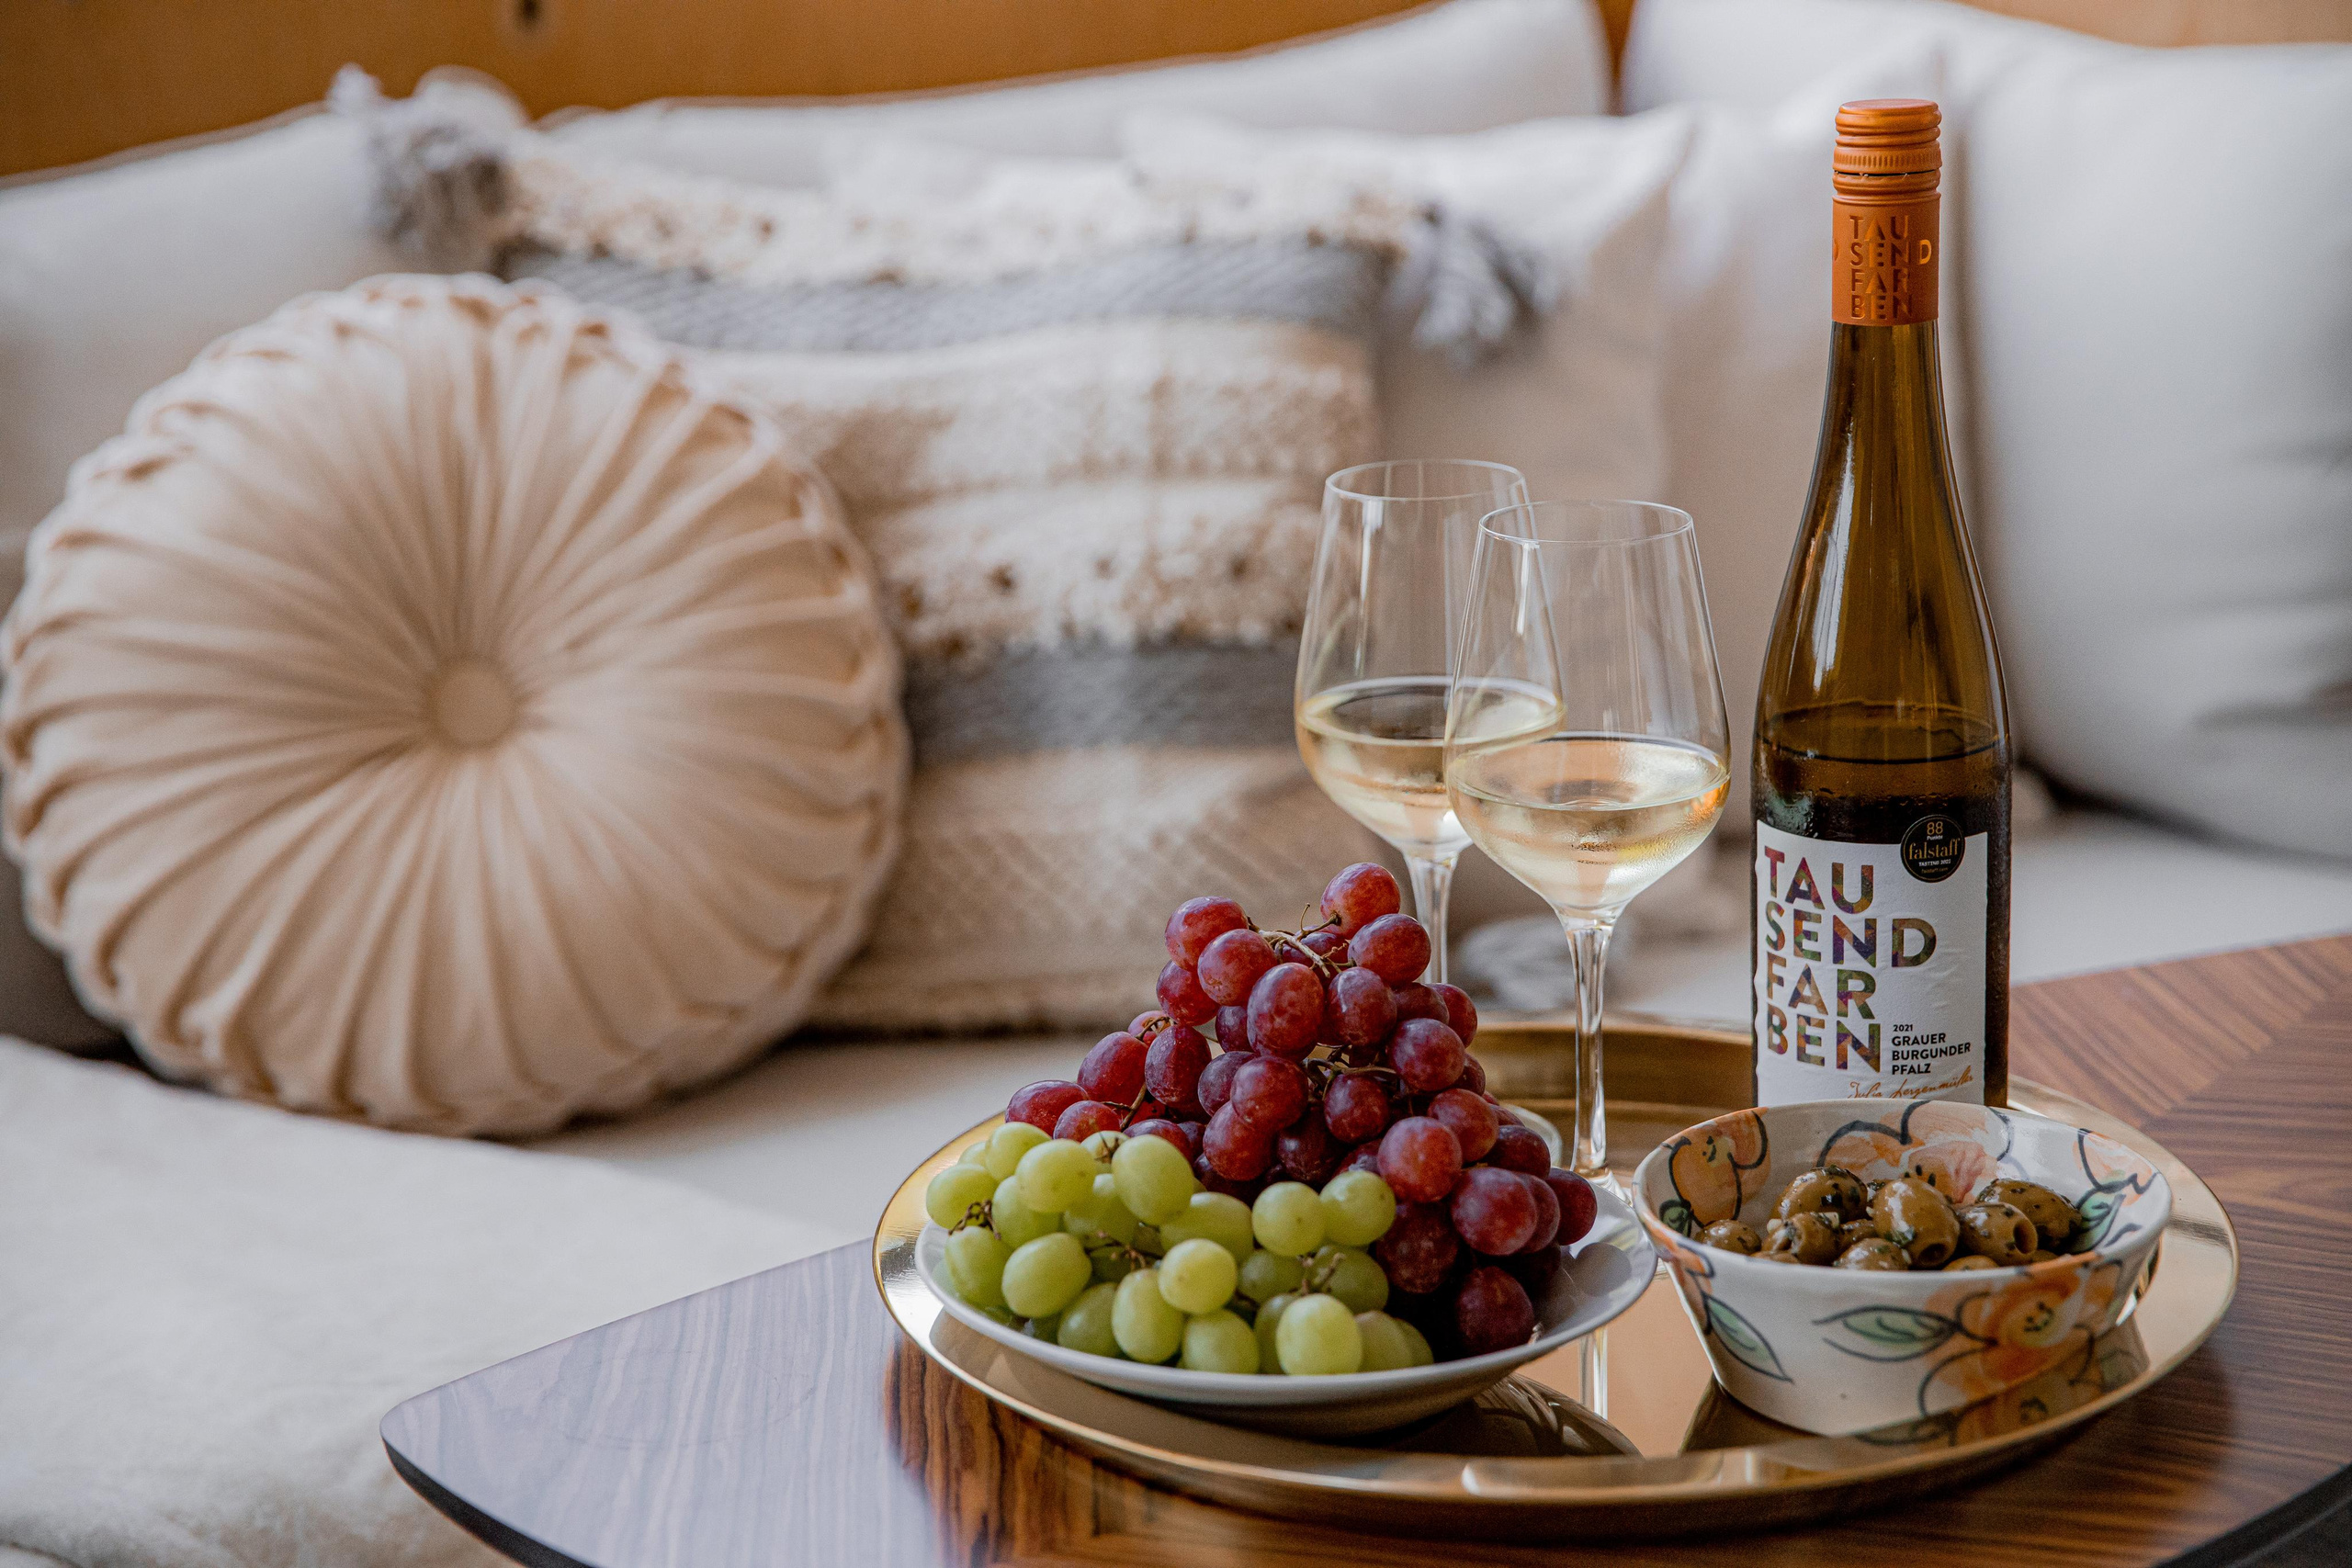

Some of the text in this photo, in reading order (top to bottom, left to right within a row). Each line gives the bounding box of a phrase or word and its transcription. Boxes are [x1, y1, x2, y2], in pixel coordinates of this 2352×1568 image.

[1849, 215, 1909, 241] TAU
[1850, 268, 1910, 294] FAR
[1850, 294, 1912, 320] BEN
[1927, 821, 1943, 835] 88
[1909, 837, 1961, 860] falstaff
[1764, 845, 1874, 914] TAU
[1765, 900, 1937, 968] SEND
[1767, 951, 1877, 1020] FAR
[1767, 1002, 1881, 1073] BEN
[1892, 1032, 1946, 1046] GRAUER
[1893, 1024, 1914, 1032] 2021
[1892, 1042, 1971, 1061] BURGUNDER
[1892, 1063, 1931, 1075] PFALZ
